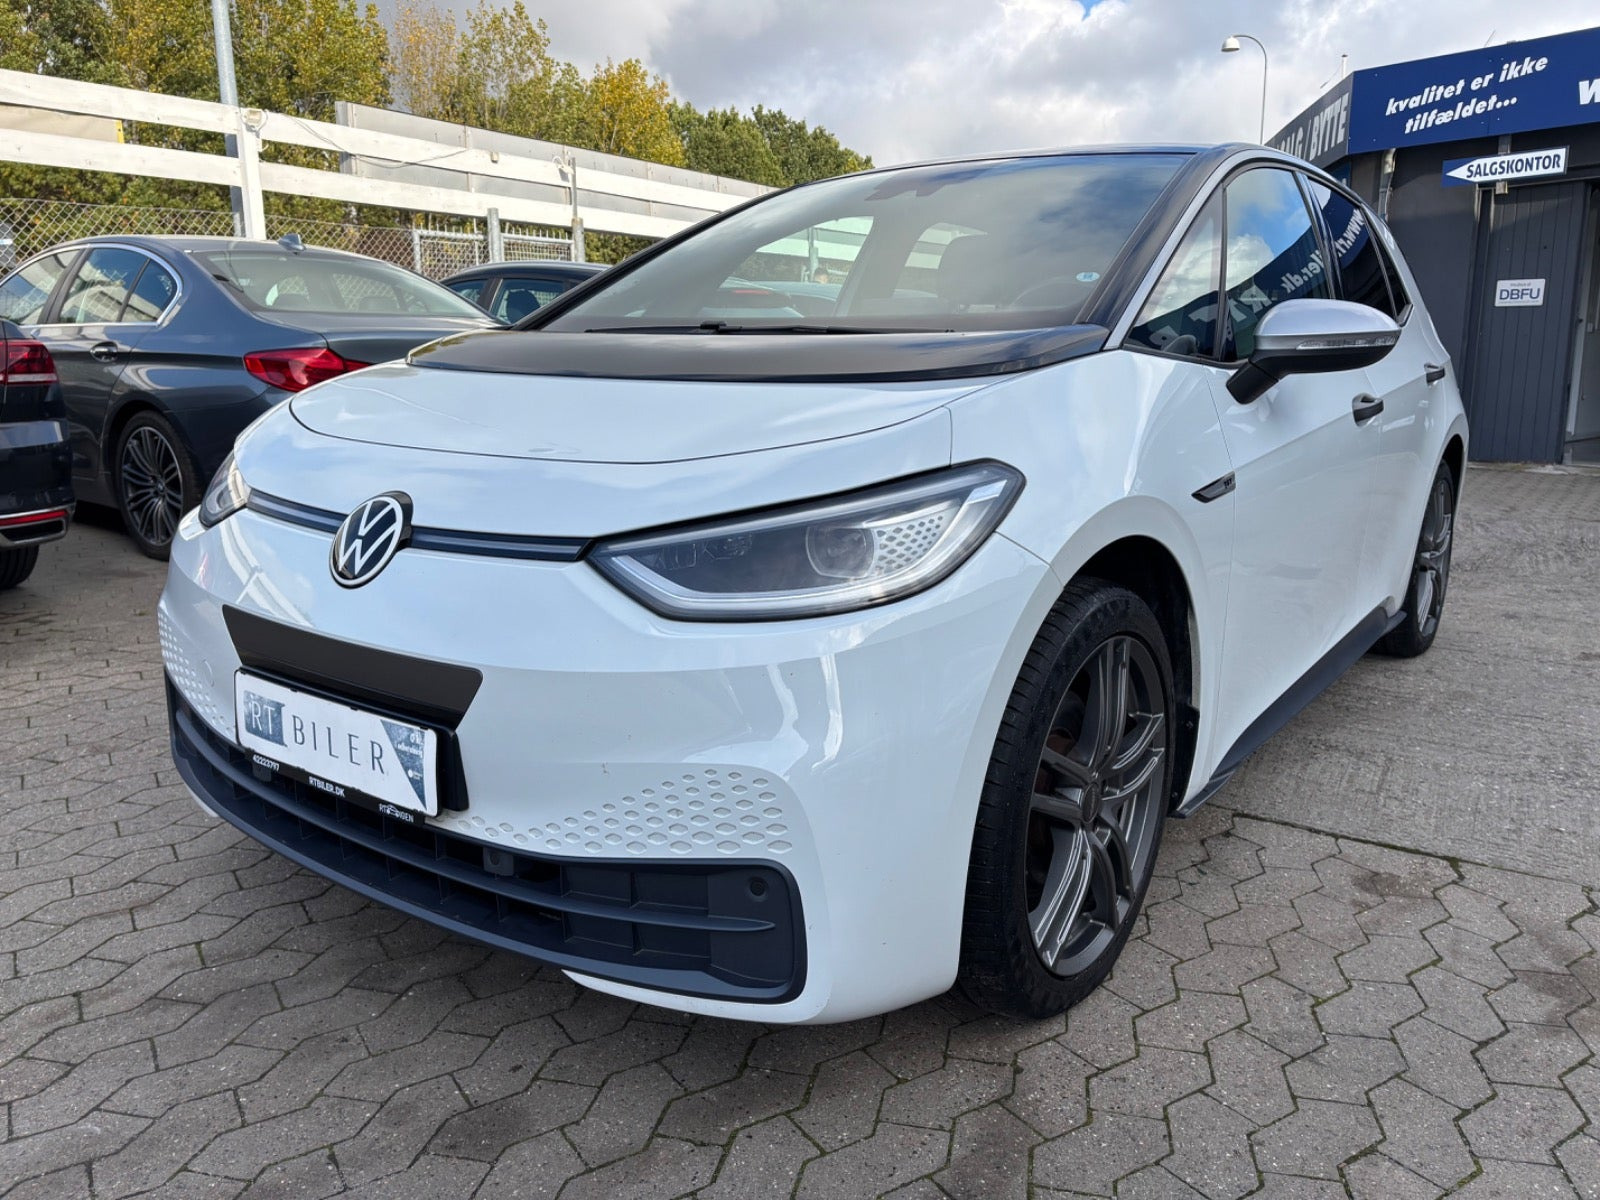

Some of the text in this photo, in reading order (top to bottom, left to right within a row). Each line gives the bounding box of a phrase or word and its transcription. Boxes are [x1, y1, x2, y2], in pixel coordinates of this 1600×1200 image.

[1385, 56, 1548, 116] kvalitet er ikke
[1309, 92, 1350, 162] BYTTE
[1405, 94, 1517, 134] tilfældet...
[1466, 154, 1561, 178] SALGSKONTOR
[1499, 287, 1541, 300] DBFU
[251, 700, 385, 775] RT BILER
